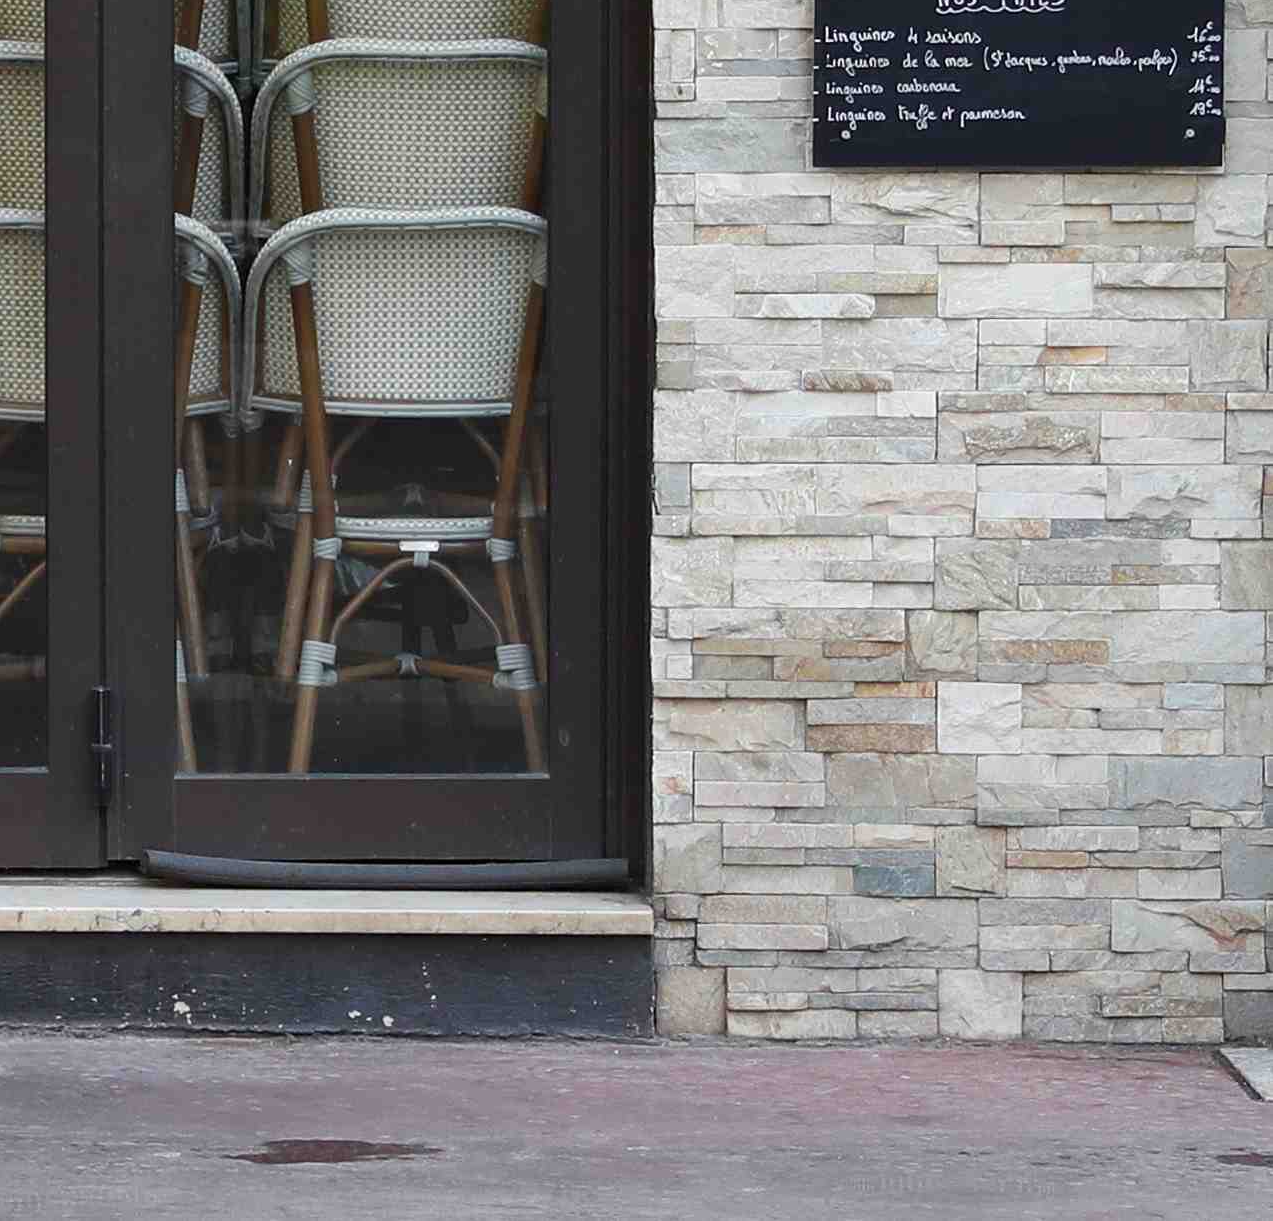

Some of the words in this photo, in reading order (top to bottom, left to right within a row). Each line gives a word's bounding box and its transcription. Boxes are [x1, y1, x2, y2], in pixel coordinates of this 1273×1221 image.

[825, 26, 895, 52] Linguines
[908, 27, 917, 44] 4
[926, 29, 981, 43] saisons
[903, 53, 918, 67] de
[925, 50, 940, 67] la
[826, 82, 883, 103] Linguines
[897, 78, 960, 93] carbonara
[828, 107, 885, 130] Linguines
[942, 106, 954, 120] et
[961, 109, 1025, 127] parmesan
